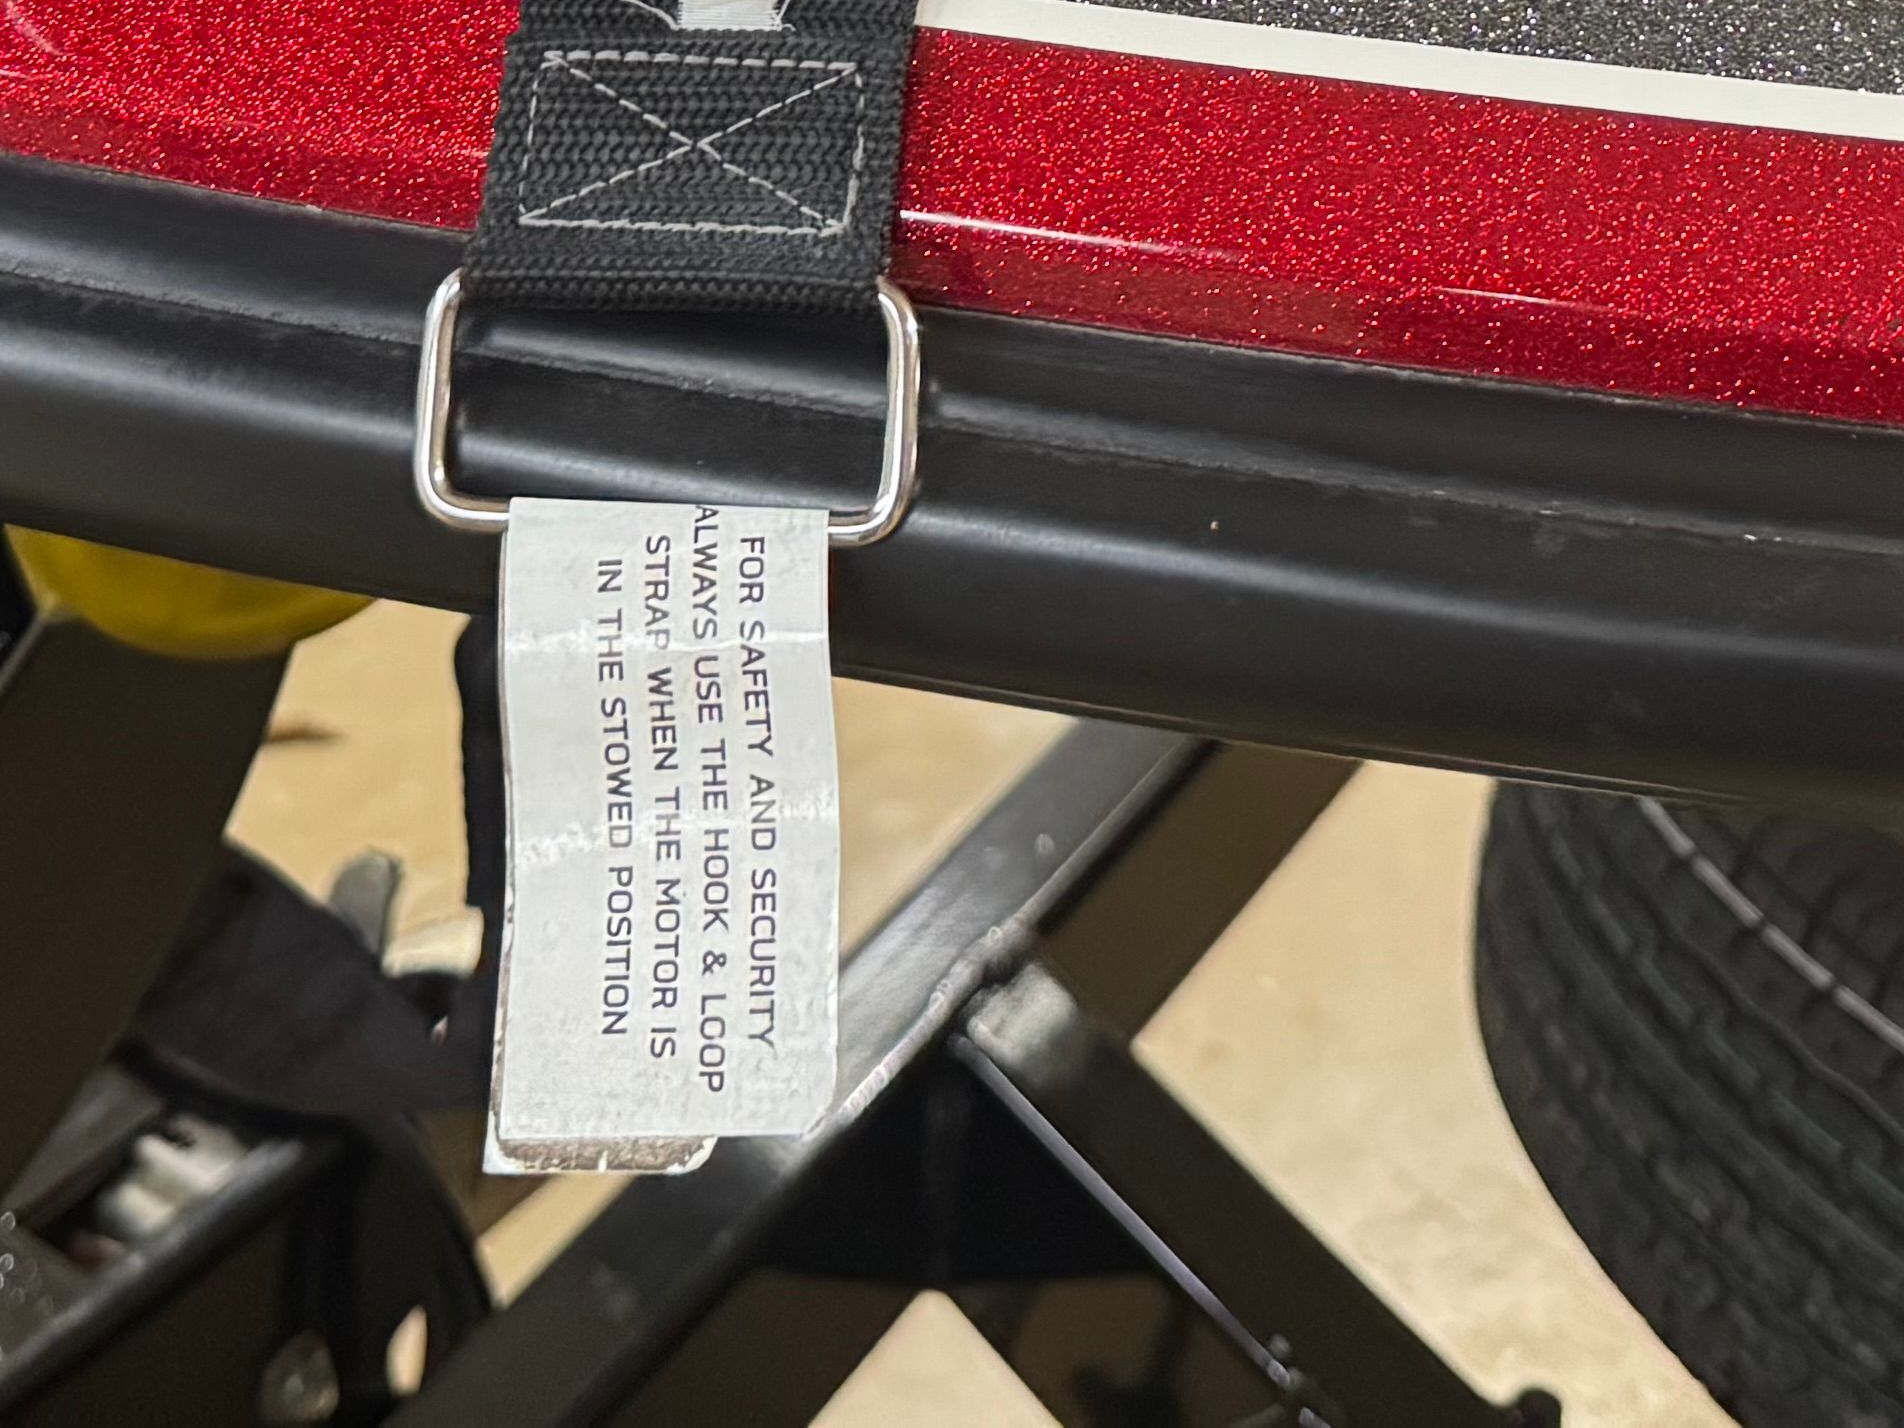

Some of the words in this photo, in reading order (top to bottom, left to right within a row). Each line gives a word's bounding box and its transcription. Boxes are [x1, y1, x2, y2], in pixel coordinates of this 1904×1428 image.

[596, 559, 623, 593] IN
[643, 535, 671, 651] STRAP
[692, 504, 720, 640] ALWAYS
[739, 536, 765, 604] FOR
[596, 608, 624, 682] THE
[693, 654, 724, 724] USE
[739, 619, 774, 758] SAFETY
[647, 666, 679, 771] WHEN
[600, 697, 633, 849] STOWED
[699, 738, 728, 811] THE
[749, 774, 777, 851] AND
[654, 786, 682, 862] THE
[702, 828, 729, 932] HOOK
[600, 865, 634, 1036] POSITION
[651, 878, 681, 1009] MOTOR
[701, 949, 728, 976] &
[748, 868, 778, 1049] SECURITY
[649, 1027, 677, 1059] IS
[698, 994, 727, 1093] LOOP
